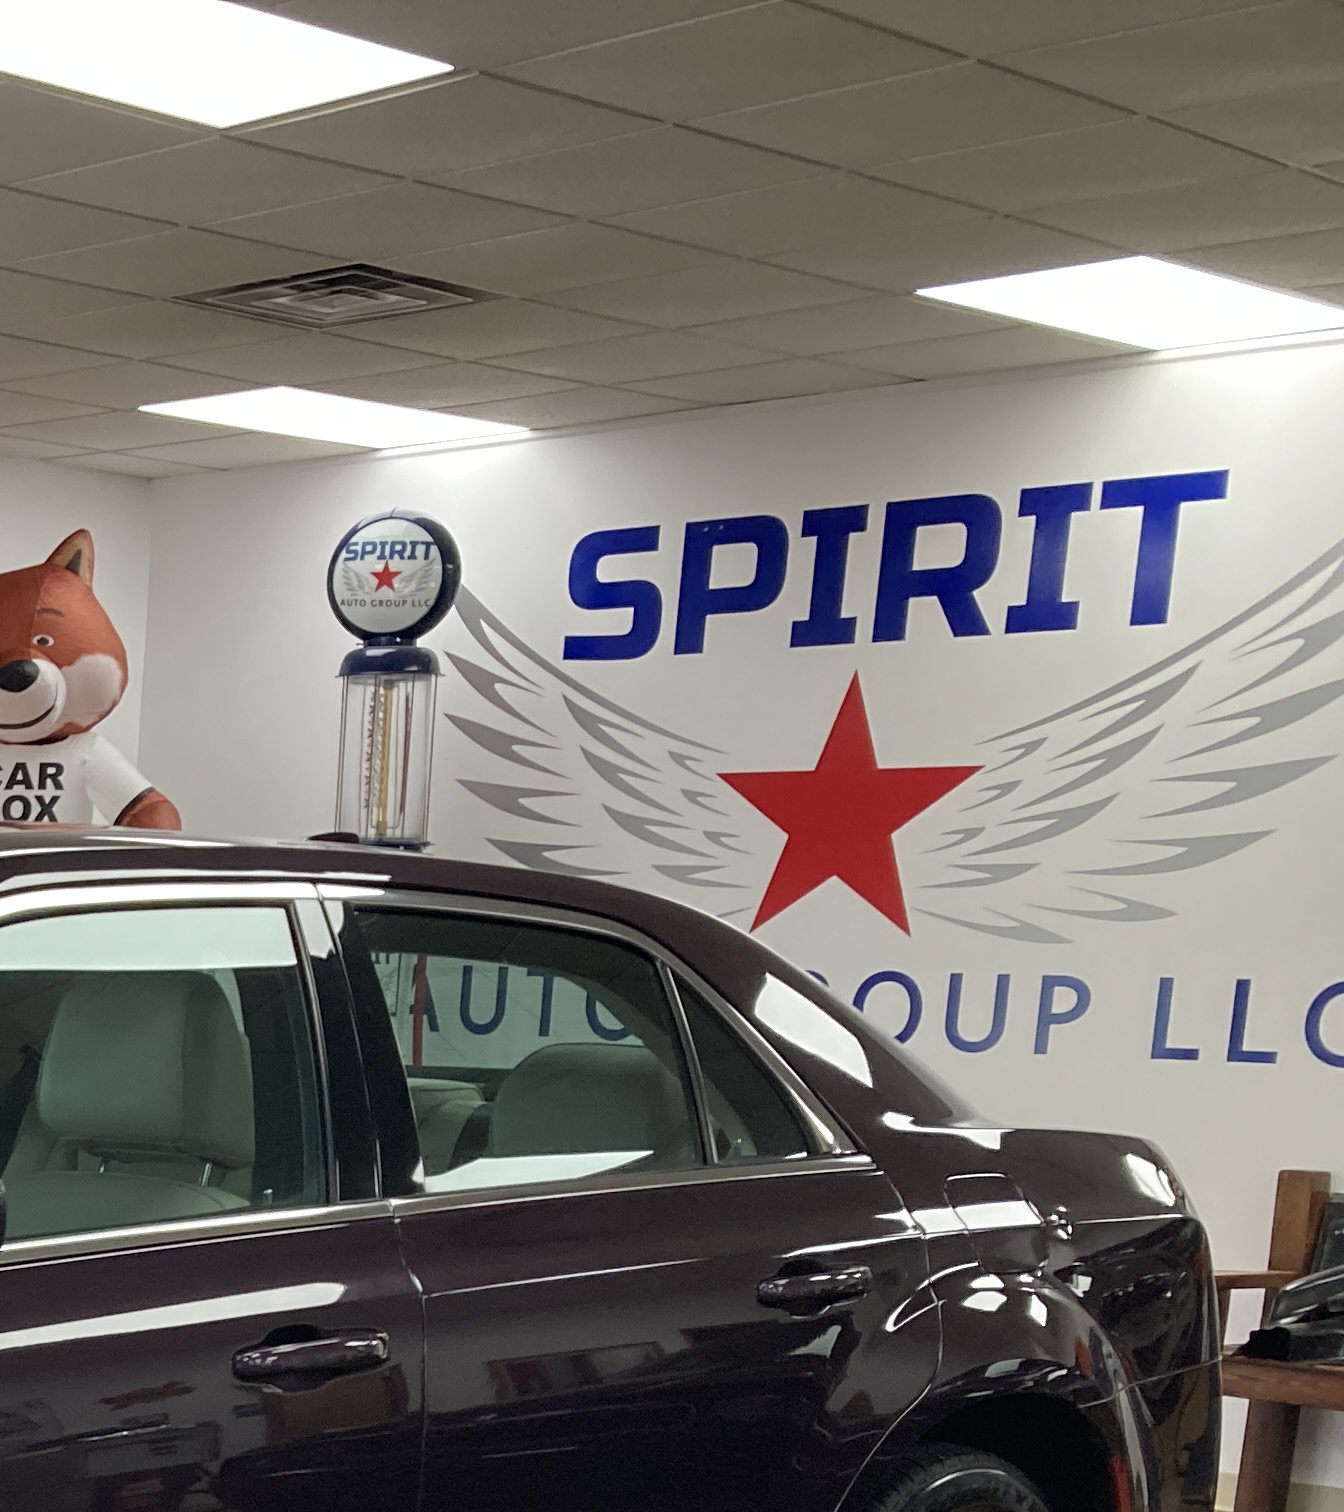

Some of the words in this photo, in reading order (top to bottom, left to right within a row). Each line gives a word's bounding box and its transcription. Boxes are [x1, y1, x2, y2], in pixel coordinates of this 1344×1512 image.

[343, 540, 436, 562] SPIRIT
[562, 468, 1229, 661] SPIRIT
[340, 599, 367, 608] AUTO
[370, 599, 408, 608] GROUP
